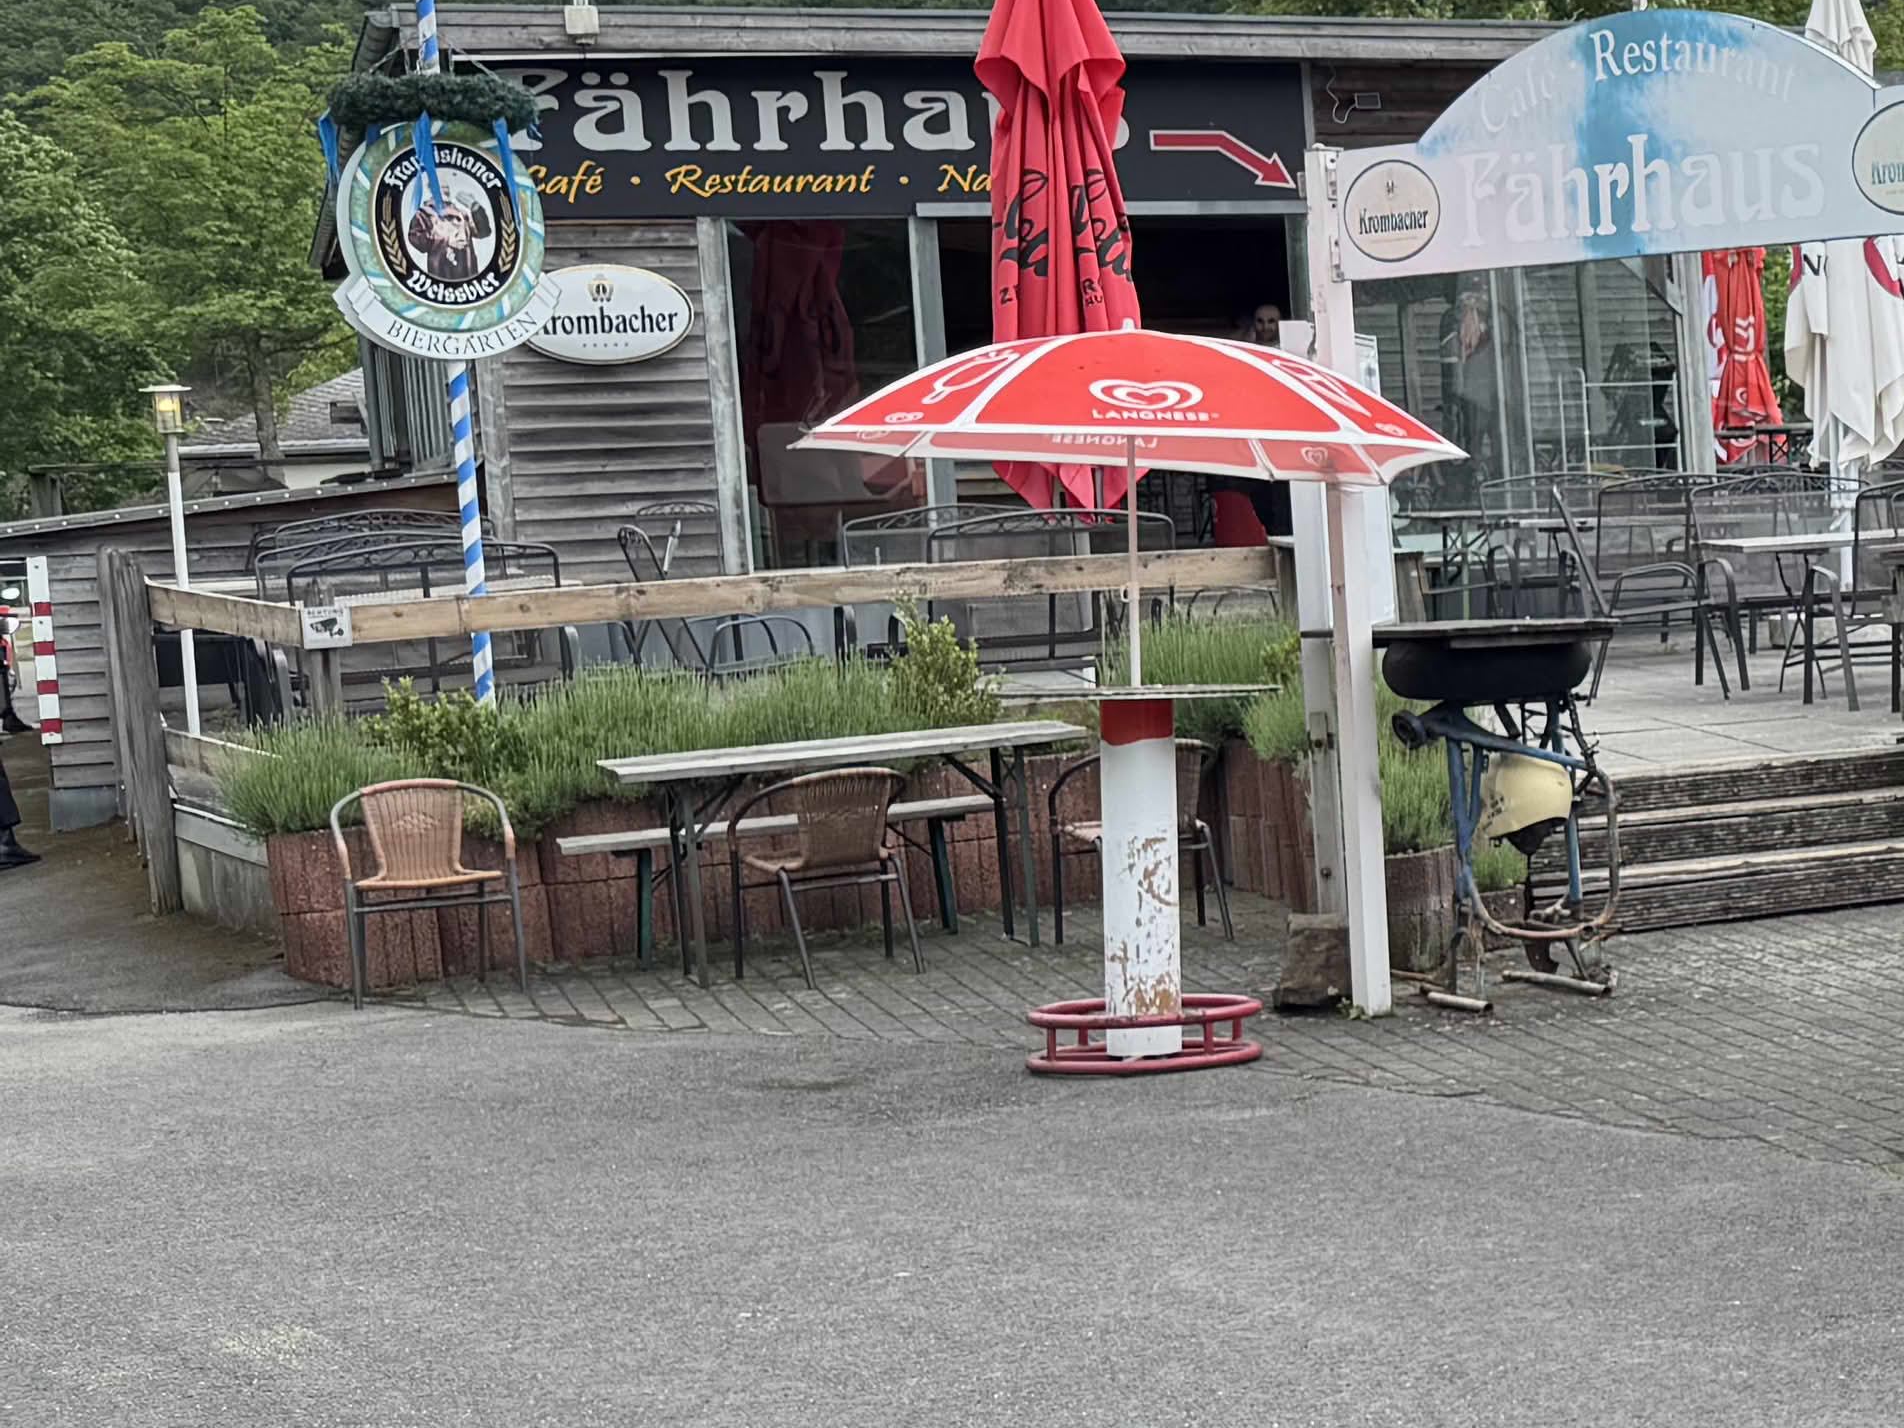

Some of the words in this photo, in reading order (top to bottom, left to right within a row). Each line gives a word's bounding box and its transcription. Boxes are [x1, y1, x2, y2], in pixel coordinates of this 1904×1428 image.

[1589, 29, 1796, 103] Restaurant
[527, 160, 606, 204] Café
[664, 164, 875, 198] Restaurant
[1460, 134, 1826, 248] Fährhaus
[1359, 208, 1429, 235] Krombacher
[405, 270, 500, 303] Weissbier
[1092, 409, 1210, 422] LANGNESE
